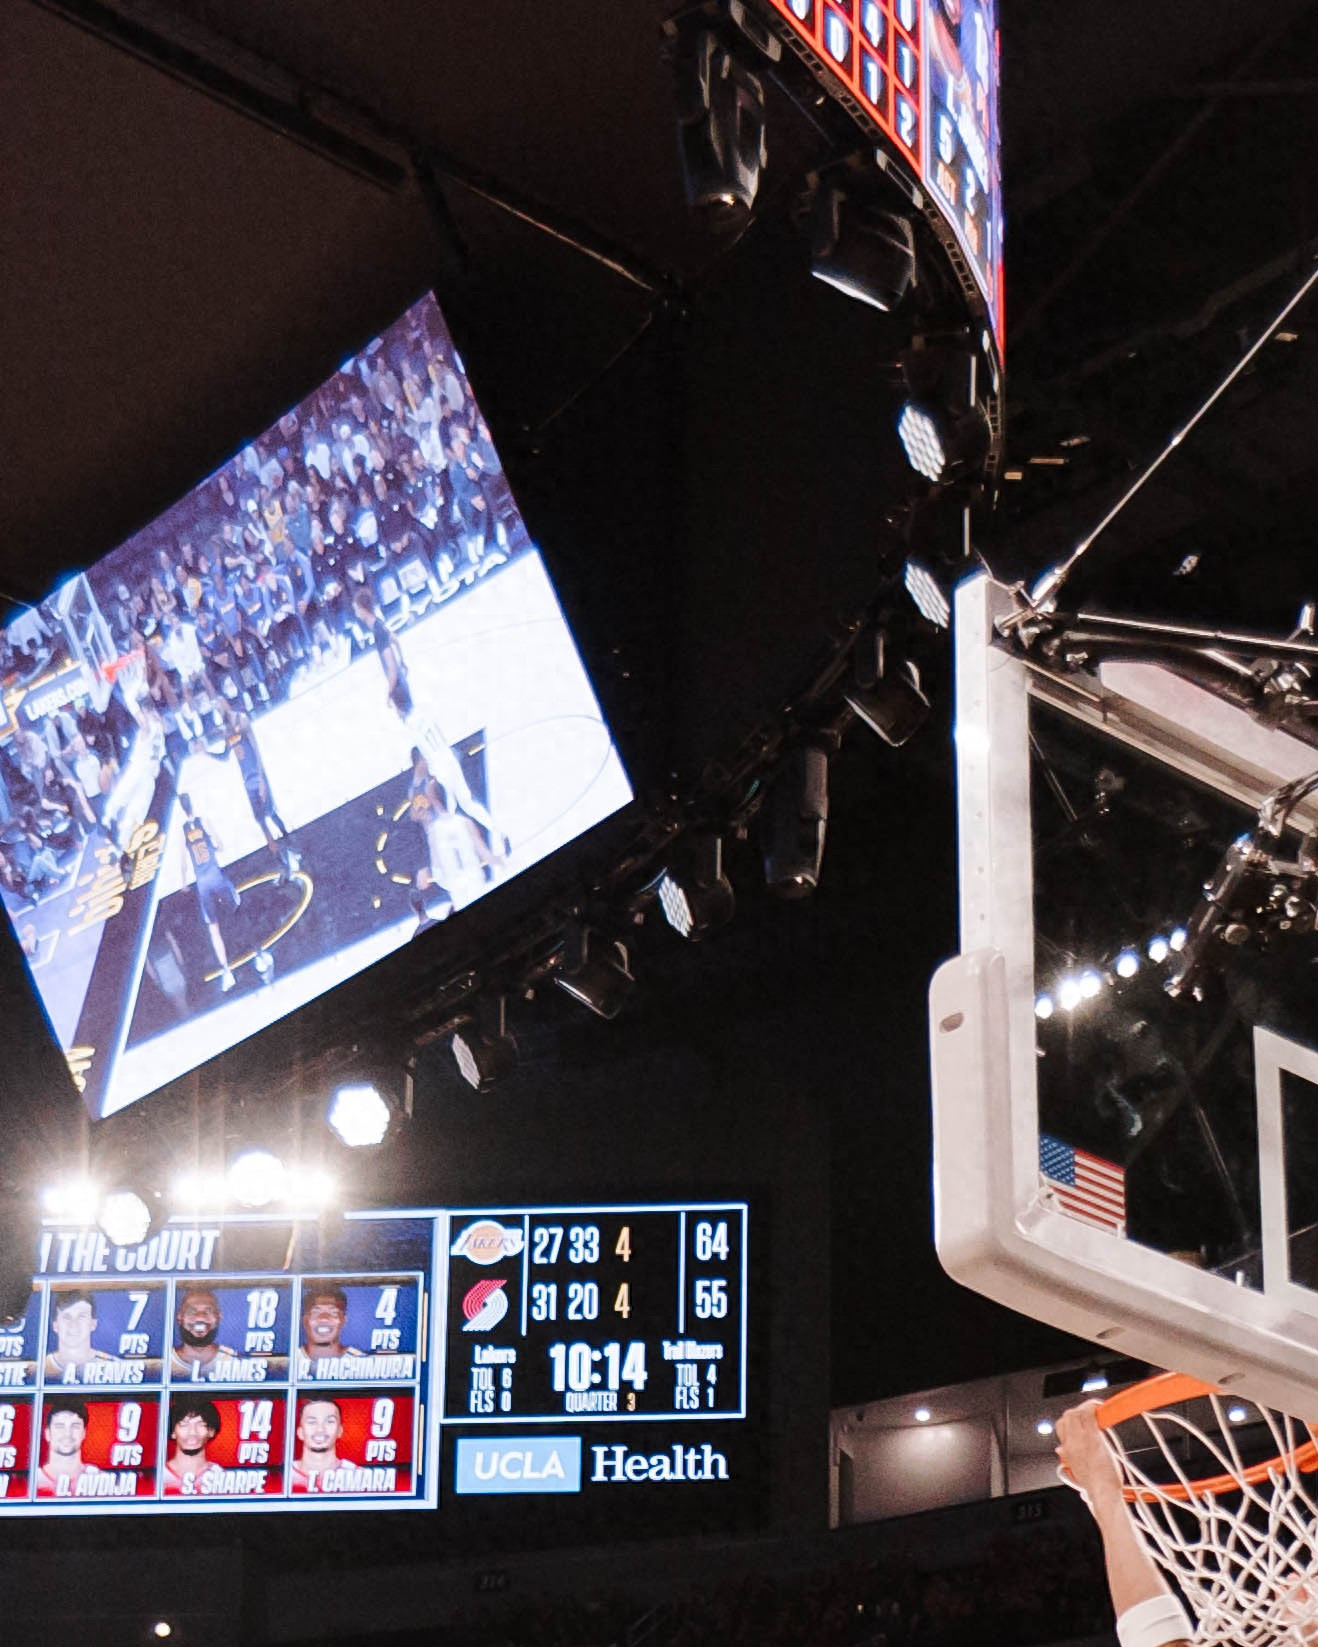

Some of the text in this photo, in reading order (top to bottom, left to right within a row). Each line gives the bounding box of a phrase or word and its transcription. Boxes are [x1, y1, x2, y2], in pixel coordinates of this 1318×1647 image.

[532, 1226, 632, 1265] 27 33 4
[696, 1222, 730, 1261] 64
[246, 1289, 279, 1329] 18
[375, 1288, 398, 1327] 4
[532, 1282, 631, 1321] 31 20 4
[695, 1279, 729, 1319] 55
[127, 1293, 149, 1331] 7
[118, 1333, 150, 1355] PTS
[244, 1331, 275, 1353] PTS
[371, 1328, 402, 1351] PTS
[63, 1360, 146, 1384] A. REAVES
[208, 1358, 268, 1382] JAMES
[316, 1356, 414, 1380] HACHIMURA
[470, 1366, 513, 1389] TOL 6
[548, 1341, 648, 1392] 10:14
[675, 1363, 717, 1387] TOL 4
[470, 1390, 513, 1413] FLS 0
[565, 1391, 637, 1412] QUARTER 3
[675, 1386, 715, 1410] FLS 1
[117, 1402, 142, 1443] 9
[238, 1399, 274, 1440] 14
[370, 1398, 395, 1438] 9
[112, 1444, 144, 1467] PTS
[238, 1442, 270, 1464] PTS
[365, 1440, 397, 1462] PTS
[473, 1444, 730, 1482] UCLA Health
[56, 1471, 137, 1497] D. AVDIJA
[182, 1470, 268, 1495] S. SHARPE
[306, 1467, 396, 1492] T. CAMARA
